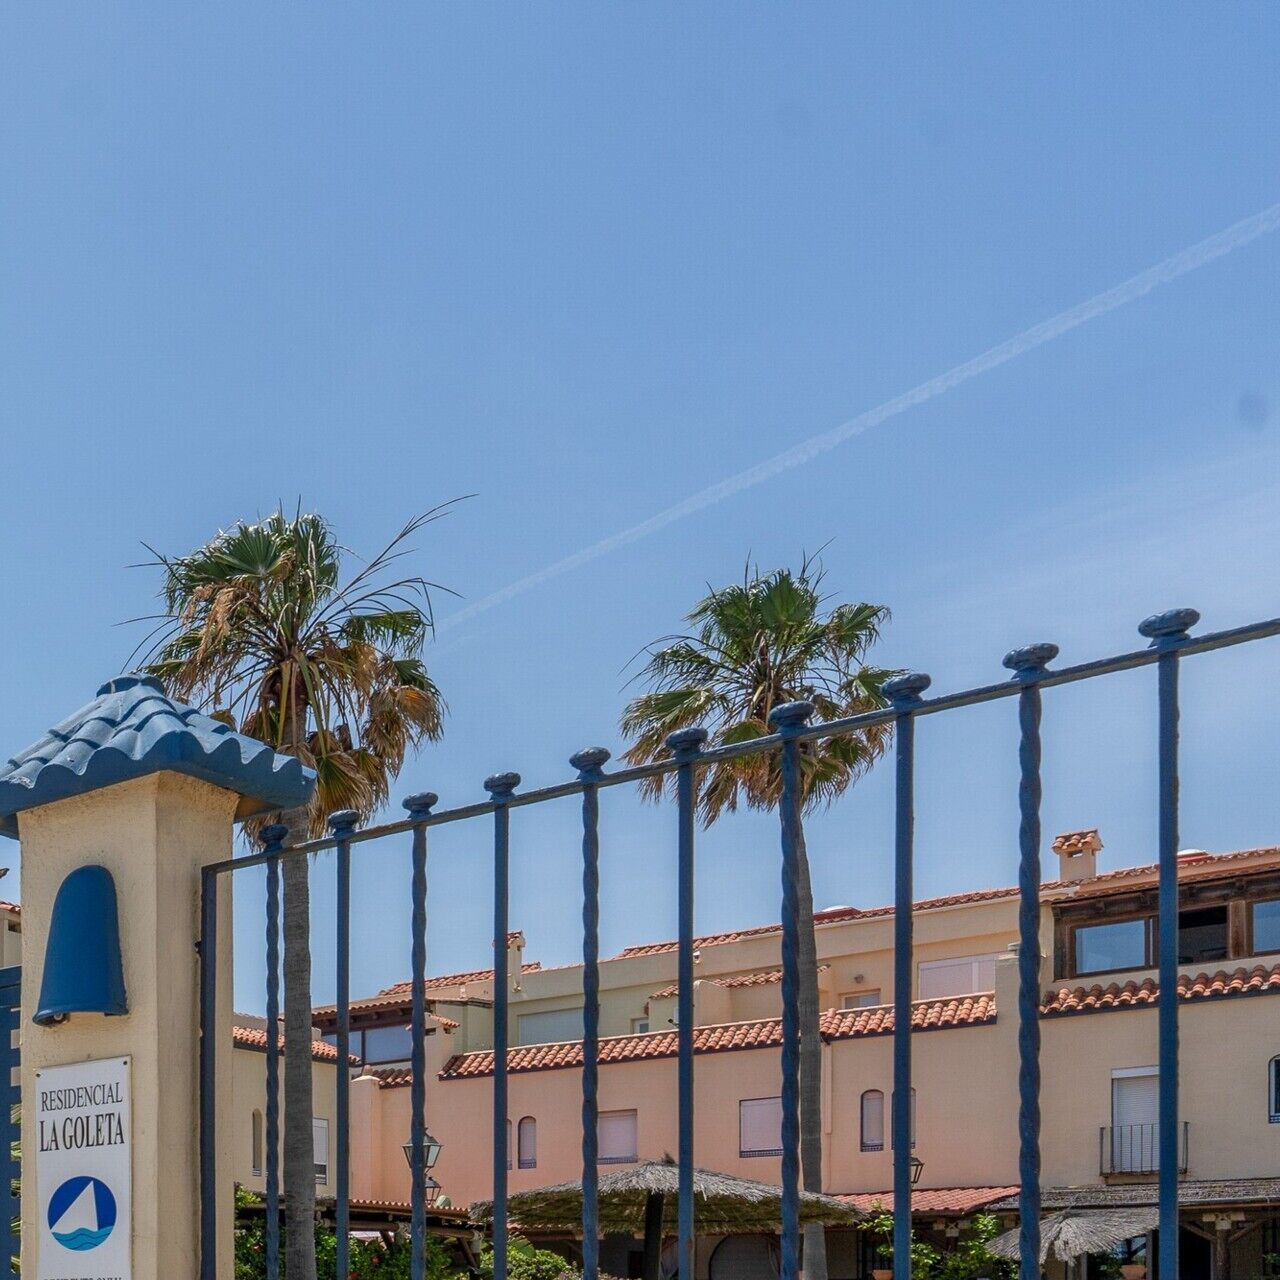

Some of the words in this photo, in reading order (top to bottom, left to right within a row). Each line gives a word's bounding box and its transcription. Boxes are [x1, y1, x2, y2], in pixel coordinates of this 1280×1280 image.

[41, 1082, 123, 1112] RESIDENCIAL
[40, 1119, 60, 1152] LA
[62, 1112, 125, 1150] GOLETA
